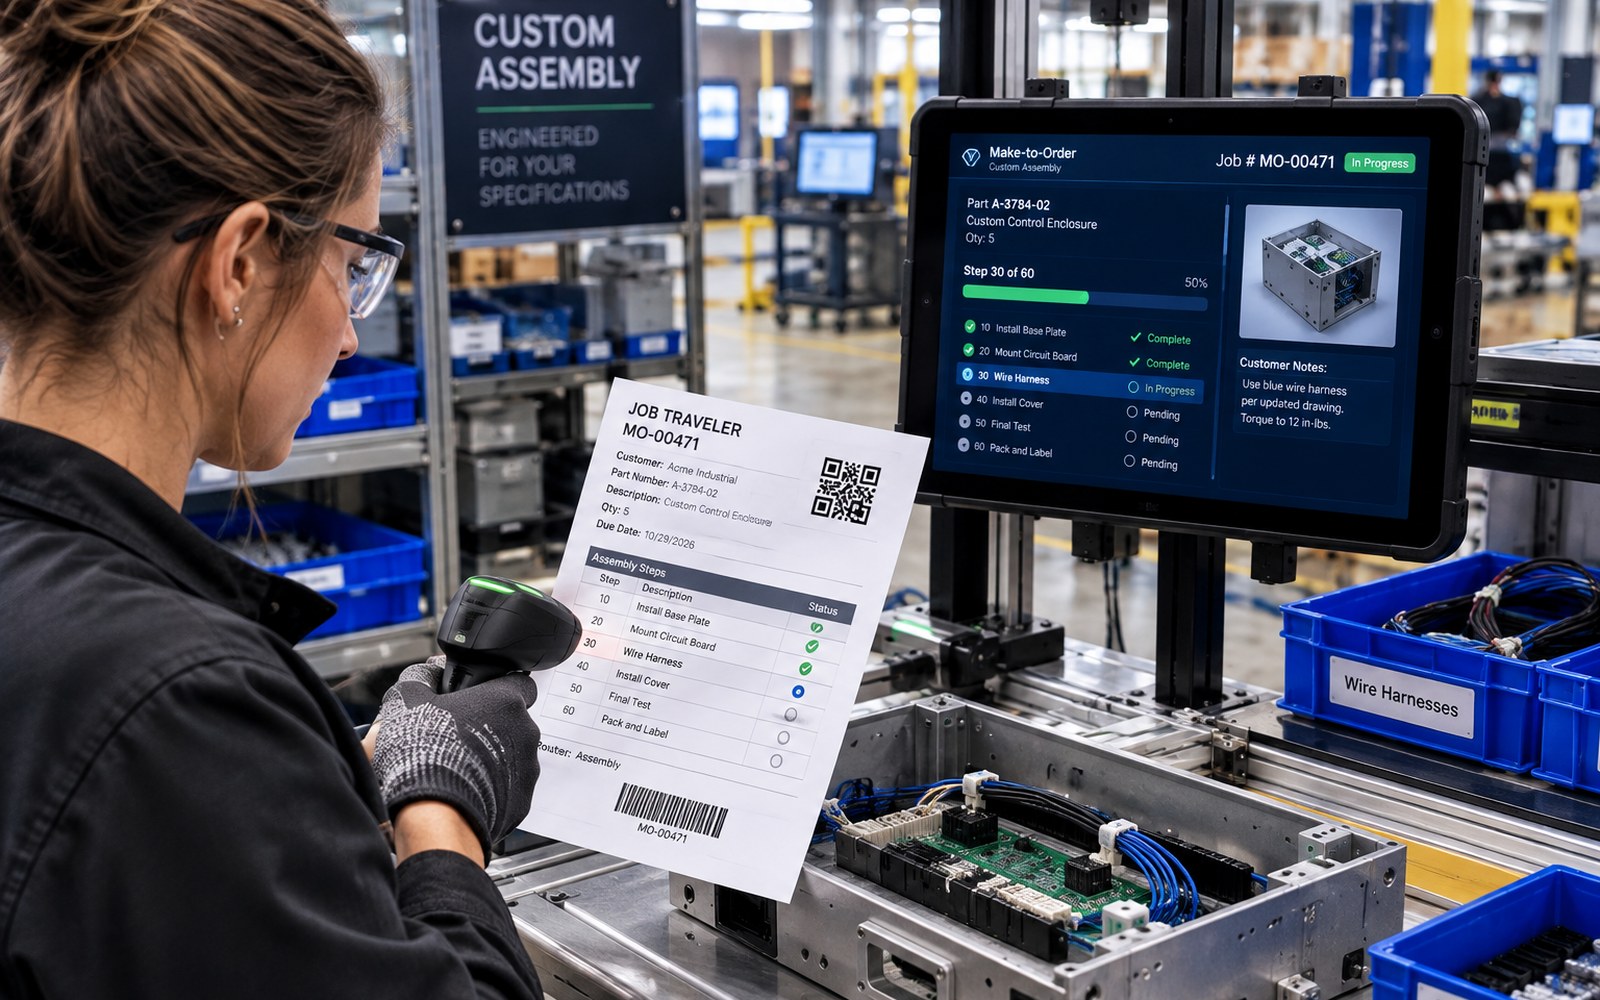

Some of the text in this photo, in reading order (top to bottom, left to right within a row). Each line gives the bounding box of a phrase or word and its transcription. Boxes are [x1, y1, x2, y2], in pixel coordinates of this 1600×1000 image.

[474, 13, 615, 48] CUSTOM
[475, 55, 641, 90] ASSEMBLY
[478, 125, 599, 150] ENGINEERED
[990, 146, 1076, 160] Make-to-Order
[1216, 154, 1334, 168] Job # MO-00471
[479, 154, 576, 178] FOR YOUR
[989, 162, 1062, 174] Custom Assembly
[1352, 158, 1408, 170] In Progress
[480, 180, 630, 208] SPECIFICATIONS
[967, 198, 1050, 210] Part A-3784-02
[966, 215, 1098, 230] Custom Control Enclosure
[988, 233, 994, 244] 5
[964, 265, 1034, 278] Step 30 of 60
[1184, 277, 1208, 288] 50%
[981, 322, 1066, 337] 10 Install Base Plate
[1148, 333, 1191, 346] Complete
[979, 346, 1077, 362] 20 Mount Circuit Board
[1146, 358, 1190, 372] Complete
[1240, 357, 1327, 374] Customer Notes:
[978, 370, 1050, 385] 30 Wire Harness
[1145, 384, 1195, 398] In Progress
[1242, 379, 1347, 396] Use blue wire harness
[976, 395, 1044, 409] 40 Install Cover
[1241, 398, 1344, 416] per updated drawing.
[628, 402, 742, 438] JOB TRAVELER
[1144, 408, 1180, 422] Pending
[1240, 413, 1274, 426] Torque
[1276, 416, 1286, 426] to
[1289, 417, 1299, 427] 12
[976, 418, 1030, 432] 50 Final Test
[622, 422, 700, 451] MO-00471
[1142, 433, 1179, 447] Pending
[974, 442, 1052, 458] 60 Pack and Label
[616, 450, 738, 485] Customer: Acme Industrial
[1141, 458, 1178, 472] Pending
[610, 467, 718, 498] Part Number: A-3784-02
[601, 502, 630, 516] Qty: 5
[606, 484, 660, 506] Description:
[664, 497, 697, 512] Custom
[698, 504, 730, 520] Control
[596, 520, 696, 550] Due Date: 10/29/2026
[591, 552, 666, 578] Assembly Steps
[600, 574, 838, 616] Step Description Status
[600, 594, 710, 628] 10 Install Base Plate
[591, 616, 716, 652] 20 Mount Circuit Board
[584, 638, 683, 669] 30 Wire Harness
[576, 660, 670, 690] 40 Install Cover
[570, 684, 651, 710] 50 Final Test
[1344, 675, 1459, 718] Wire Harnesses
[562, 705, 669, 740] 60 Pack and Label
[575, 751, 621, 770] Assembly
[637, 822, 688, 844] MO-00471
